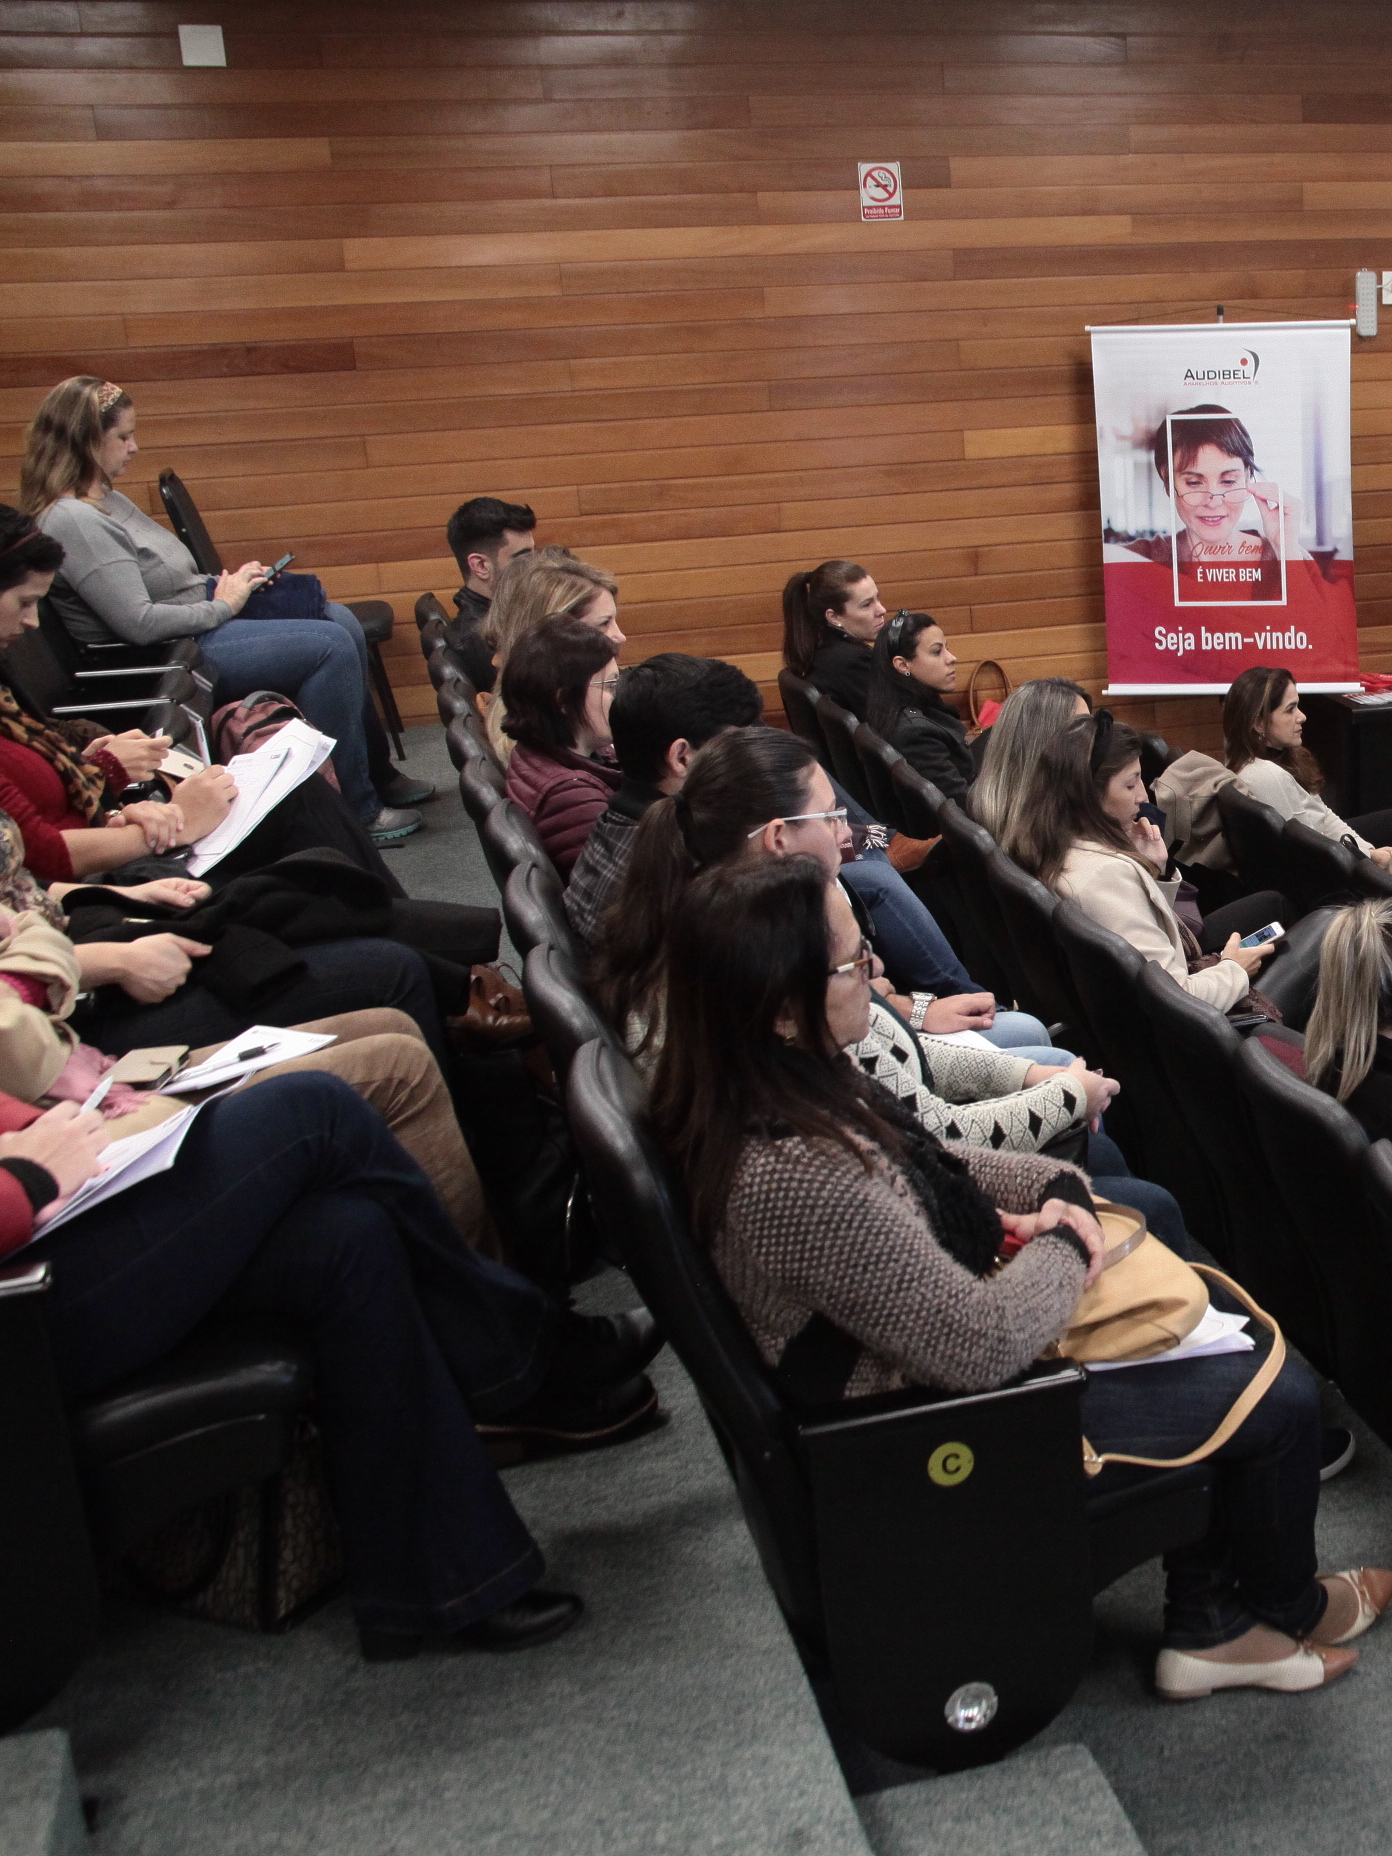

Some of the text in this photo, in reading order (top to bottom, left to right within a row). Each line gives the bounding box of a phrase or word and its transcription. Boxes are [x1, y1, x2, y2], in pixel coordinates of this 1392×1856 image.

[1184, 368, 1251, 380] AUDIBEL
[1191, 540, 1264, 558] Ouvir bem
[1197, 566, 1261, 582] É VIVER BEM
[1154, 625, 1313, 656] Seja bem-vindo.
[942, 1453, 961, 1475] C
